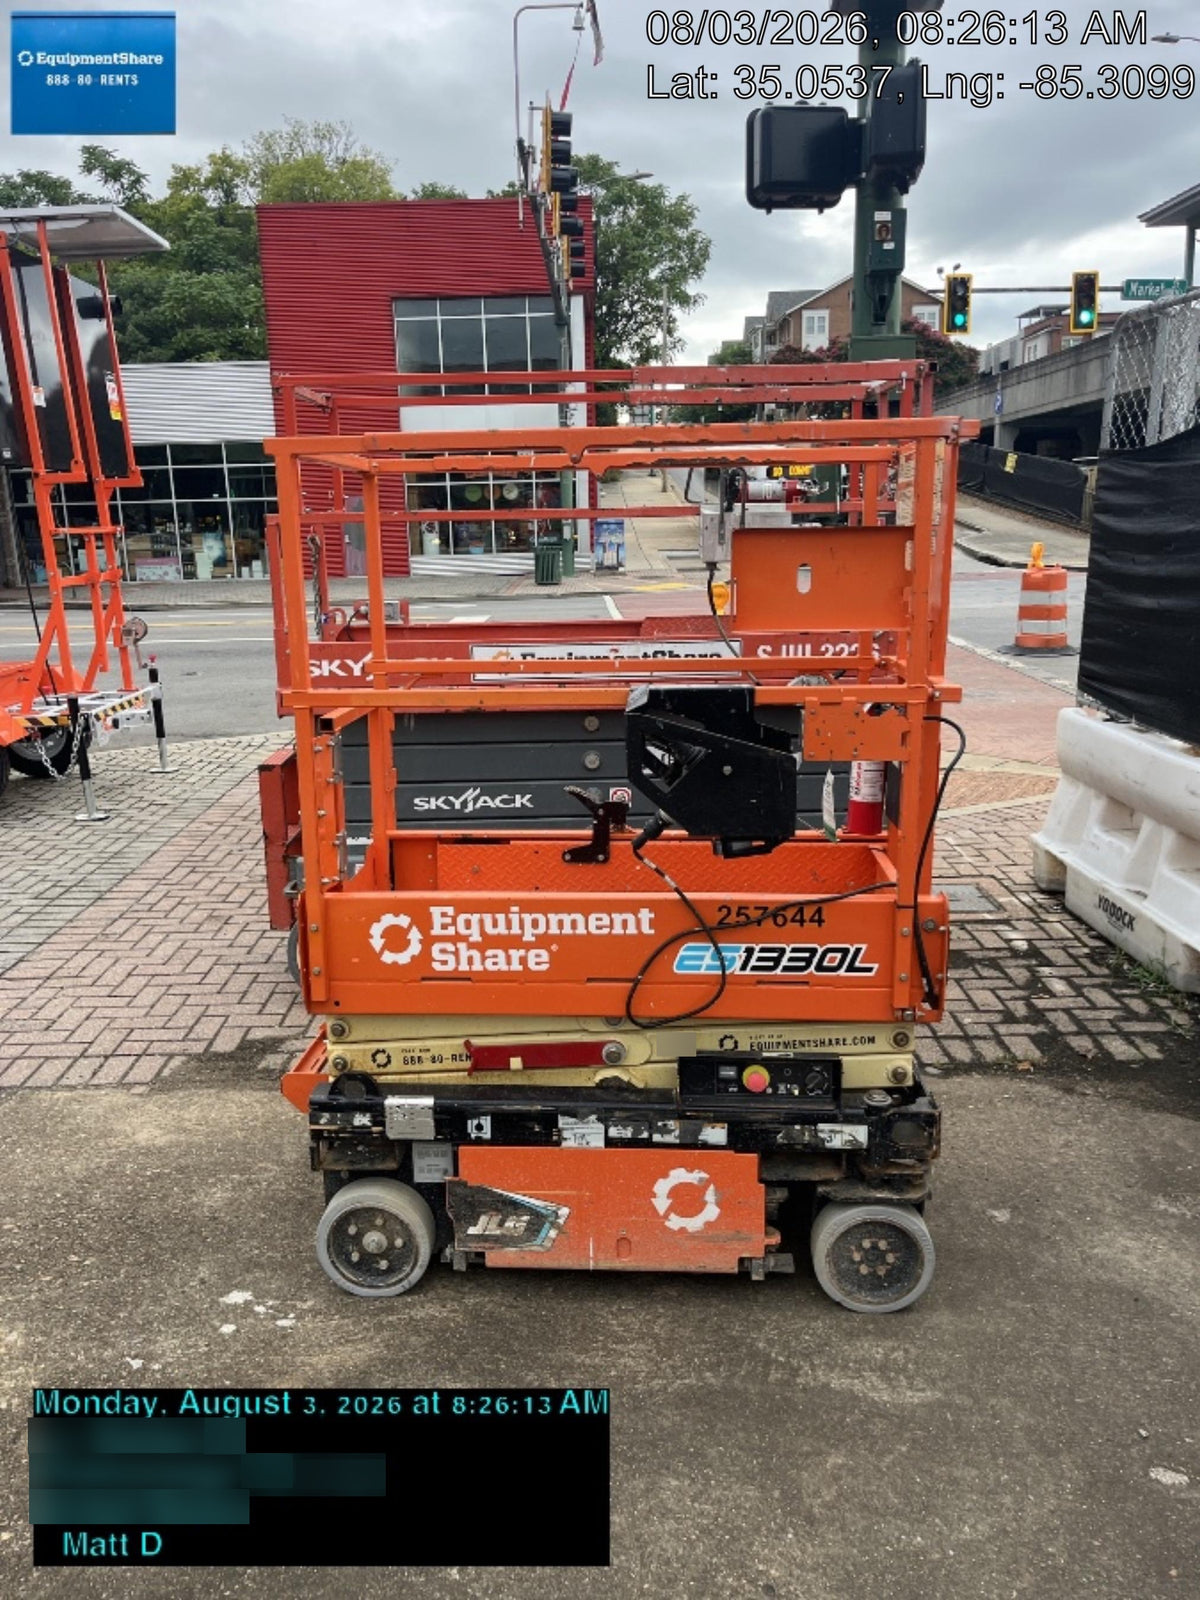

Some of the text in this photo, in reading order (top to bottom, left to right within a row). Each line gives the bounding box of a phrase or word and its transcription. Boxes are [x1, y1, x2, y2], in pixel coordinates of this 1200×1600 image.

[1129, 281, 1166, 297] Market
[413, 787, 534, 813] SKYJACK
[429, 906, 655, 942] Equipment
[717, 905, 825, 928] 257644
[674, 942, 879, 976] ES1330L
[750, 1035, 876, 1051] EQUIPMENTSHARE.COM
[402, 1052, 472, 1066] 888-80-REN
